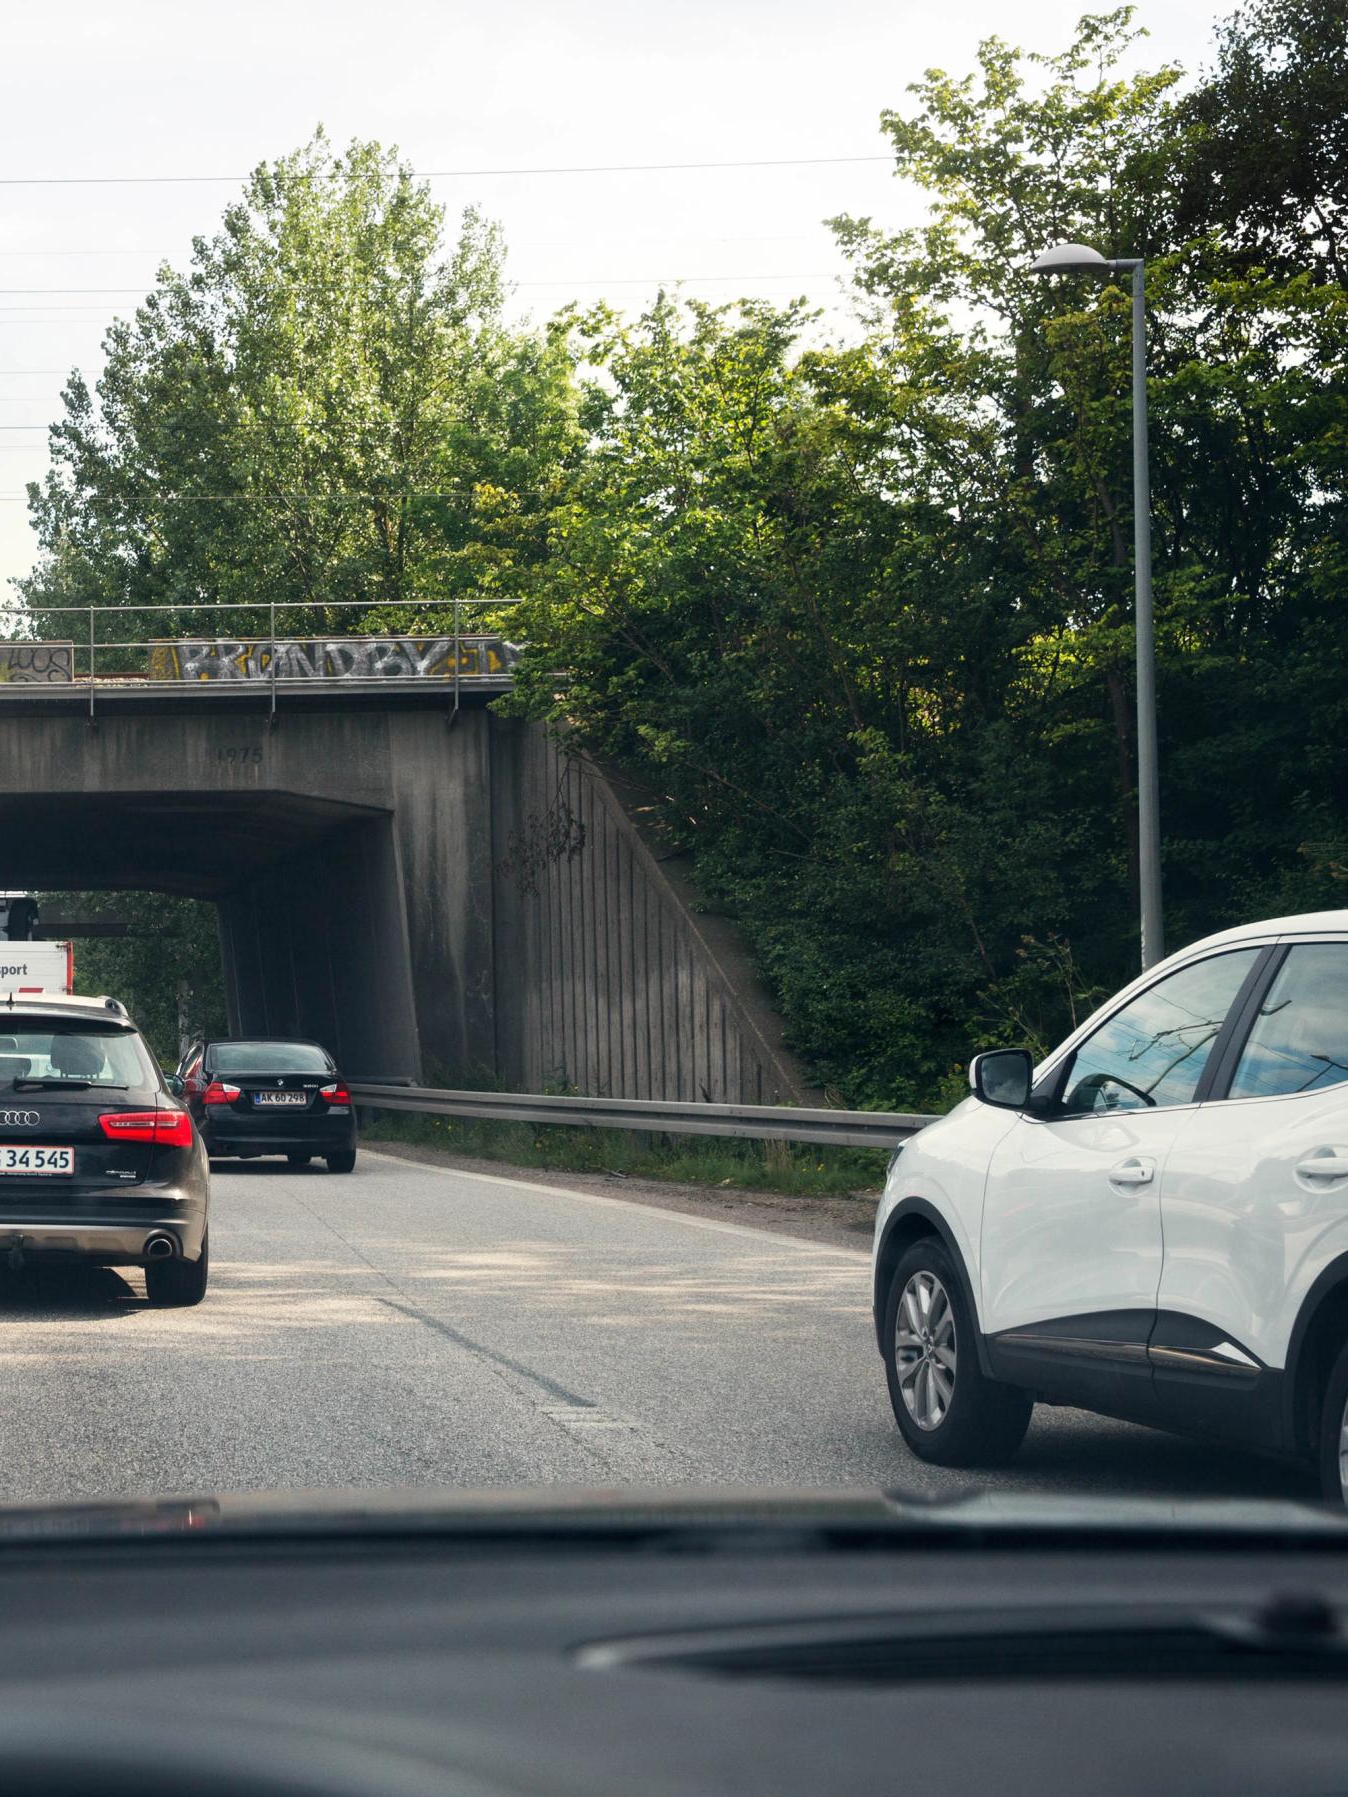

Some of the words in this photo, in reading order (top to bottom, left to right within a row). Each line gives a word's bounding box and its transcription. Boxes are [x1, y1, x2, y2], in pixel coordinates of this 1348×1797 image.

[261, 1093, 274, 1102] AK
[6, 1149, 30, 1168] 34
[34, 1150, 70, 1169] 545
